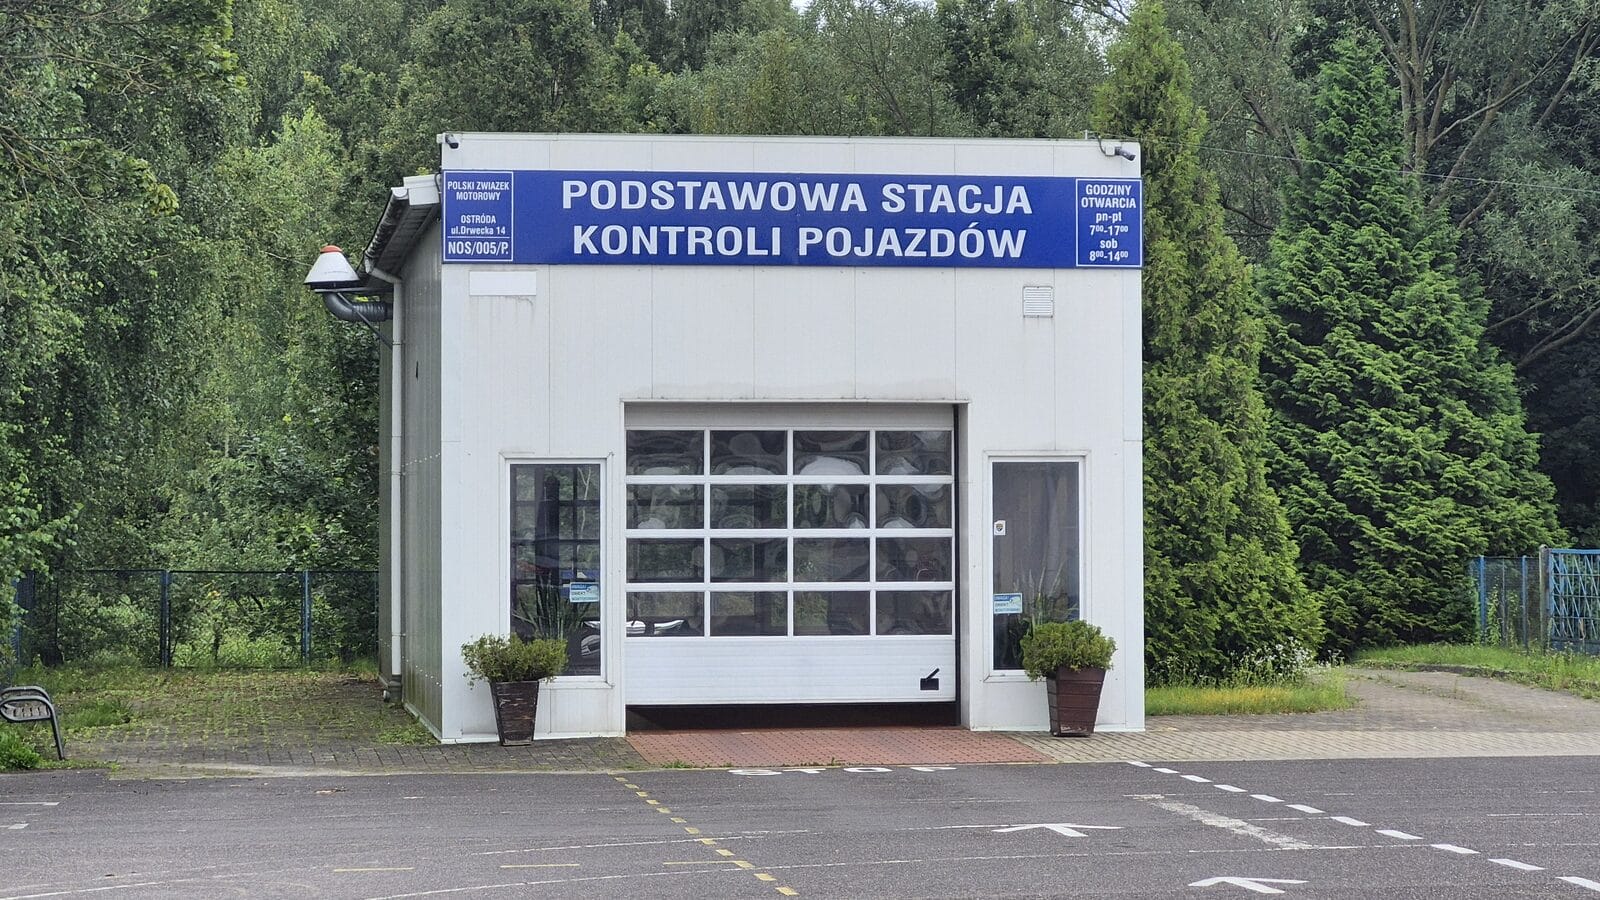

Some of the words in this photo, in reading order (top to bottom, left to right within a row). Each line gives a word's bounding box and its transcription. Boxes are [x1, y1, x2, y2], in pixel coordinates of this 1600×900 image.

[447, 181, 474, 190] POLSKI
[1085, 184, 1132, 195] GODZINY
[456, 191, 501, 200] MOTOROWY
[562, 180, 868, 213] PODSTAWOWA
[881, 184, 1033, 215] STACJA
[1081, 197, 1136, 208] OTWARCIA
[460, 213, 496, 224] OSTRÓDA
[1095, 211, 1122, 223] pn-pt
[496, 226, 506, 235] 14
[573, 225, 781, 256] KONTROLI
[798, 222, 1027, 258] POJAZDÓW
[1099, 238, 1118, 249] sob
